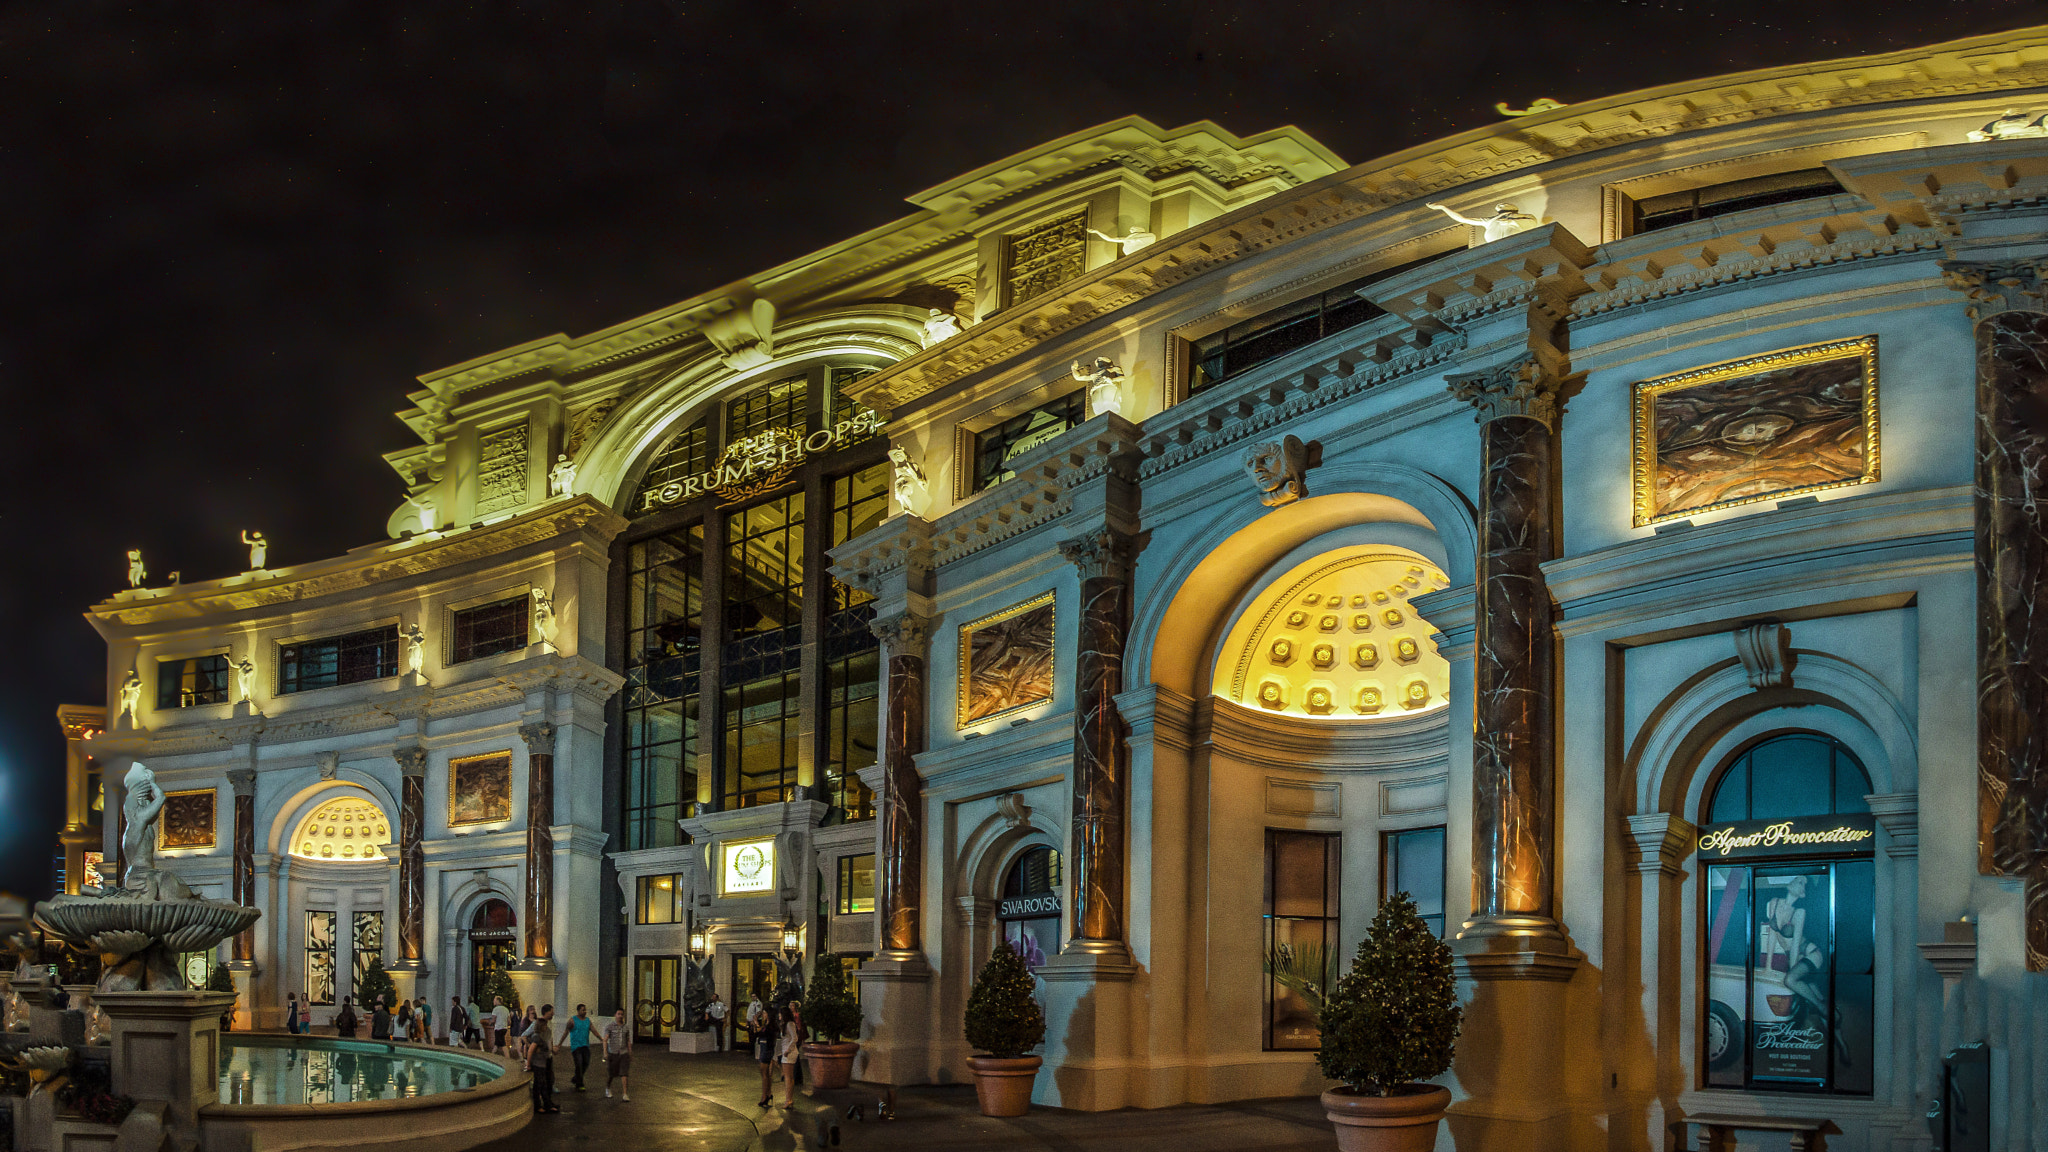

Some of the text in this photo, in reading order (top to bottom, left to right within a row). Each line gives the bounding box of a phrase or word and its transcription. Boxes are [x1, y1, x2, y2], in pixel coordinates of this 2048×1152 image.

[727, 428, 776, 459] THE
[642, 411, 868, 510] FORUM SHOPS
[1699, 821, 1873, 856] Agent Provocateur
[1001, 896, 1062, 915] SWAROVSK
